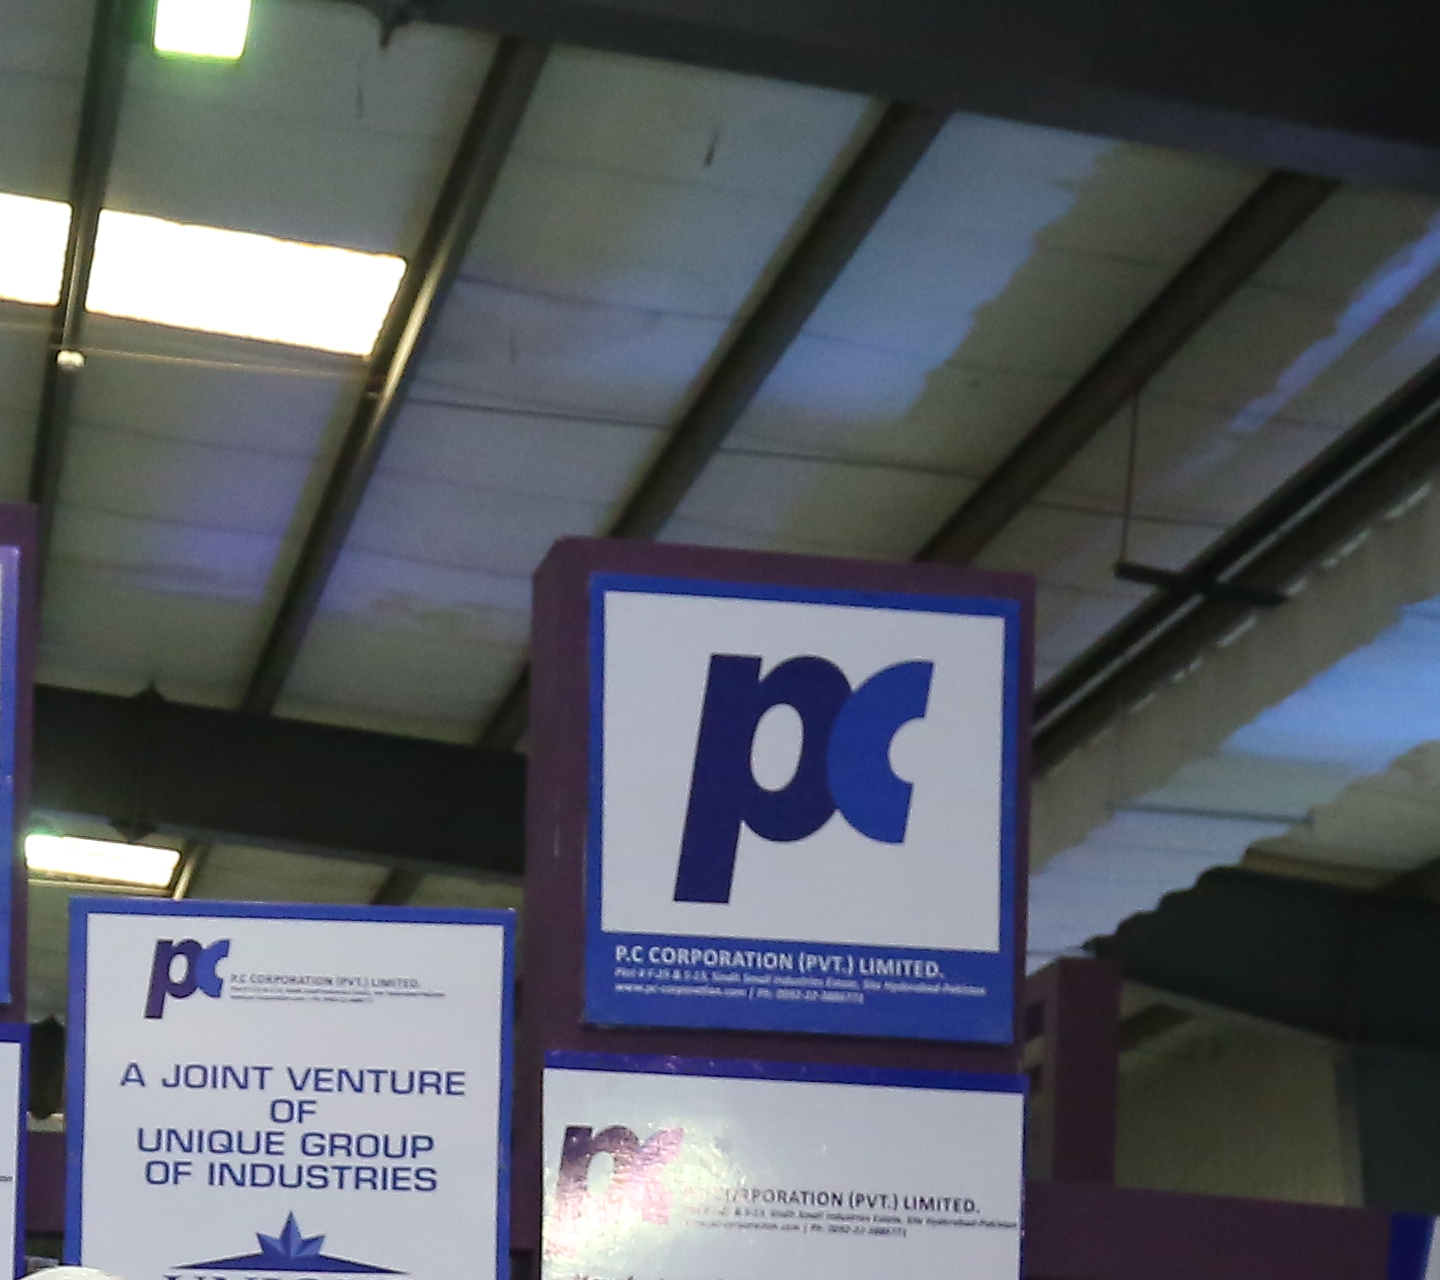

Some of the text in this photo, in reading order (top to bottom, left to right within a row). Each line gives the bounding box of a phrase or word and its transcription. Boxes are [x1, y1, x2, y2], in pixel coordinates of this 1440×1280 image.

[673, 652, 934, 903] pc
[145, 938, 230, 1019] pc
[615, 945, 945, 979] P.C CORPORATION (PVT.) LIMITED.
[120, 1062, 466, 1096] A JOINT VENTURE
[270, 1099, 318, 1124] OF
[138, 1128, 435, 1159] UNIQUE GROUP
[145, 1160, 438, 1192] OF INDUSTRIES
[849, 1191, 898, 1211] (PVT.)
[903, 1196, 980, 1214] LIMITED.
